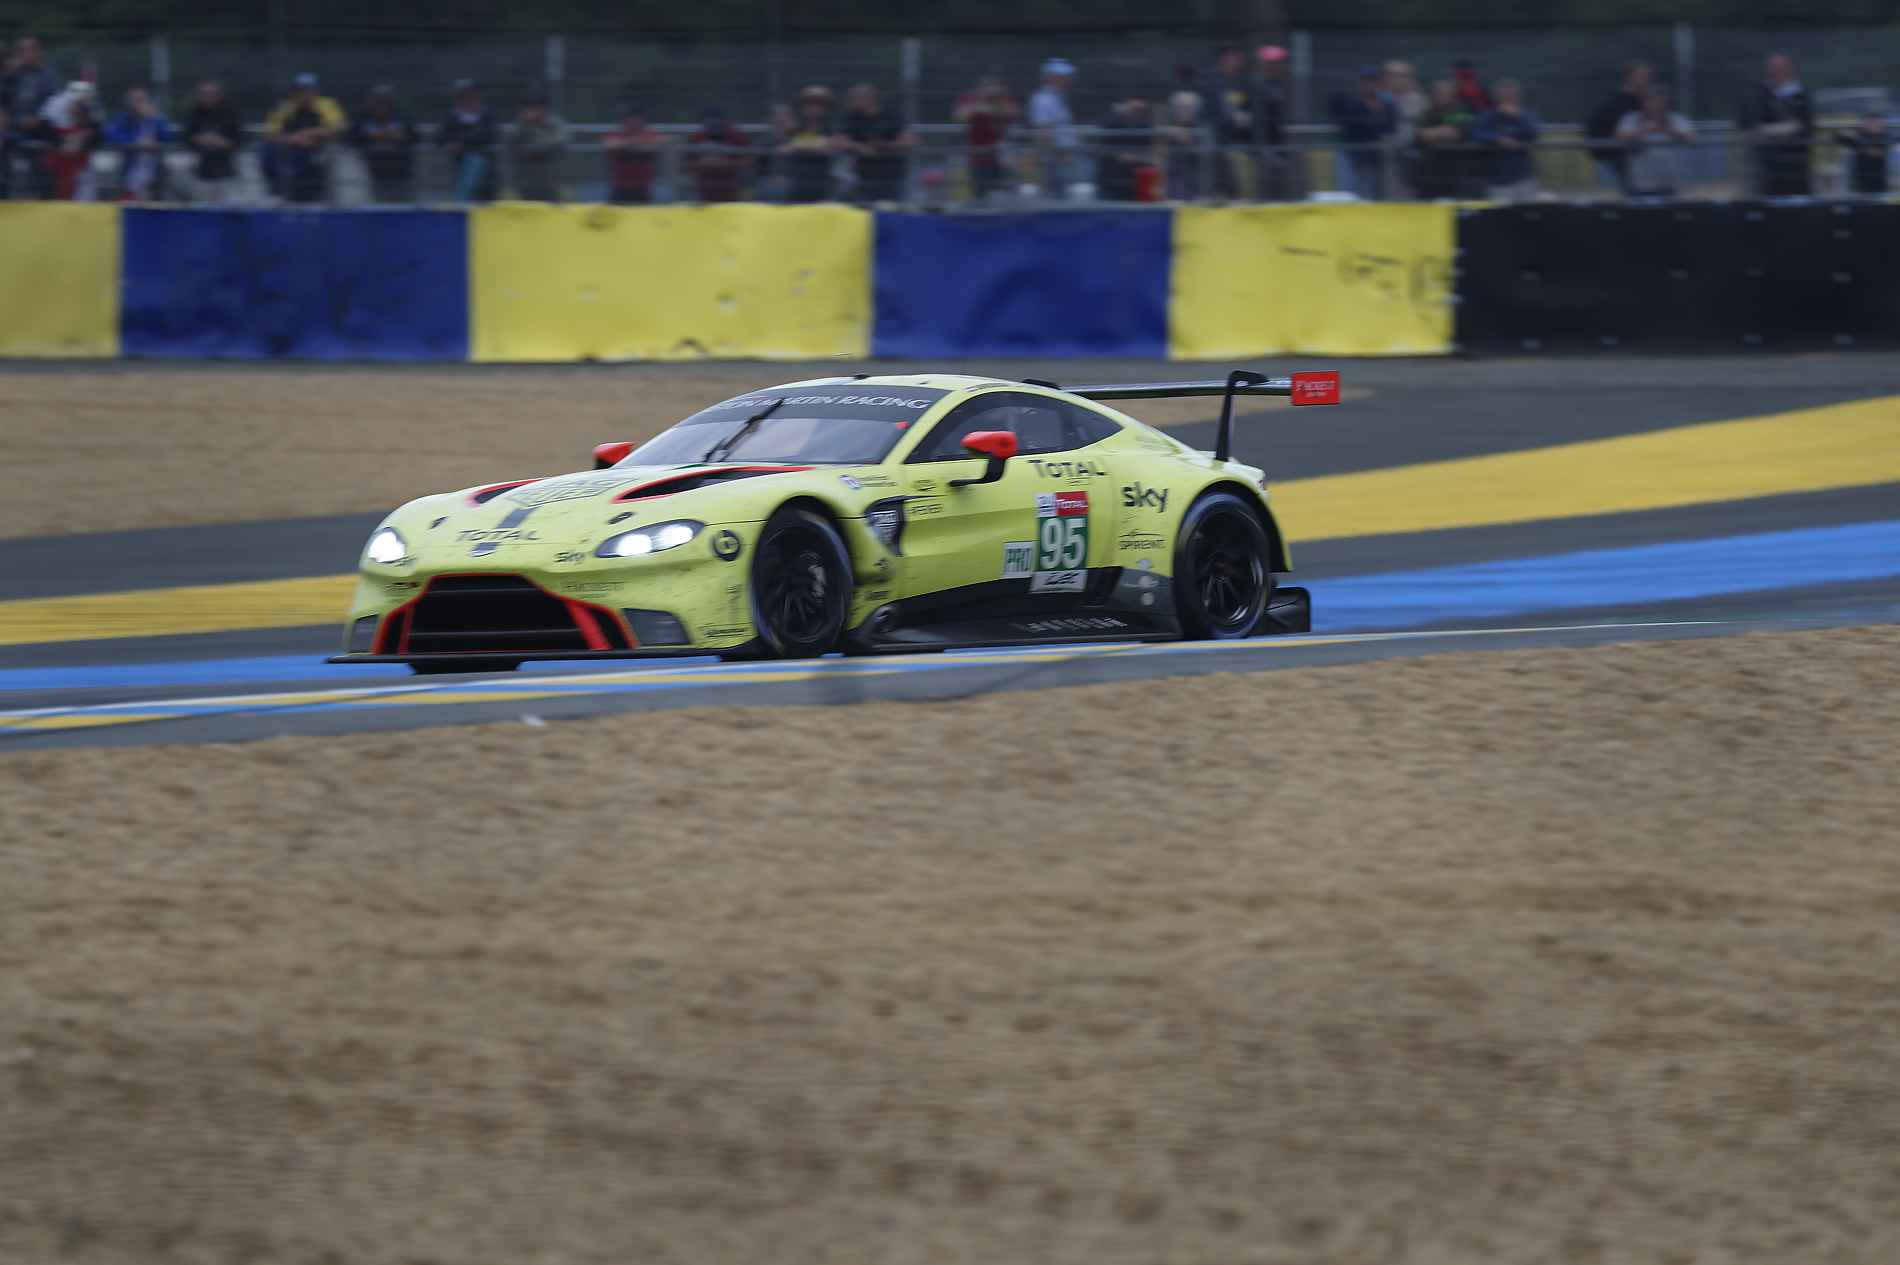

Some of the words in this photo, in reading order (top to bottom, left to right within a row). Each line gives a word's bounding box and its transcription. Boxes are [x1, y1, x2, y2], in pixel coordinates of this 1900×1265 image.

[839, 395, 932, 409] RACING
[1028, 459, 1107, 478] TOTAL
[1122, 481, 1168, 513] sky
[456, 529, 540, 542] TOTAL
[1040, 518, 1086, 570] 95
